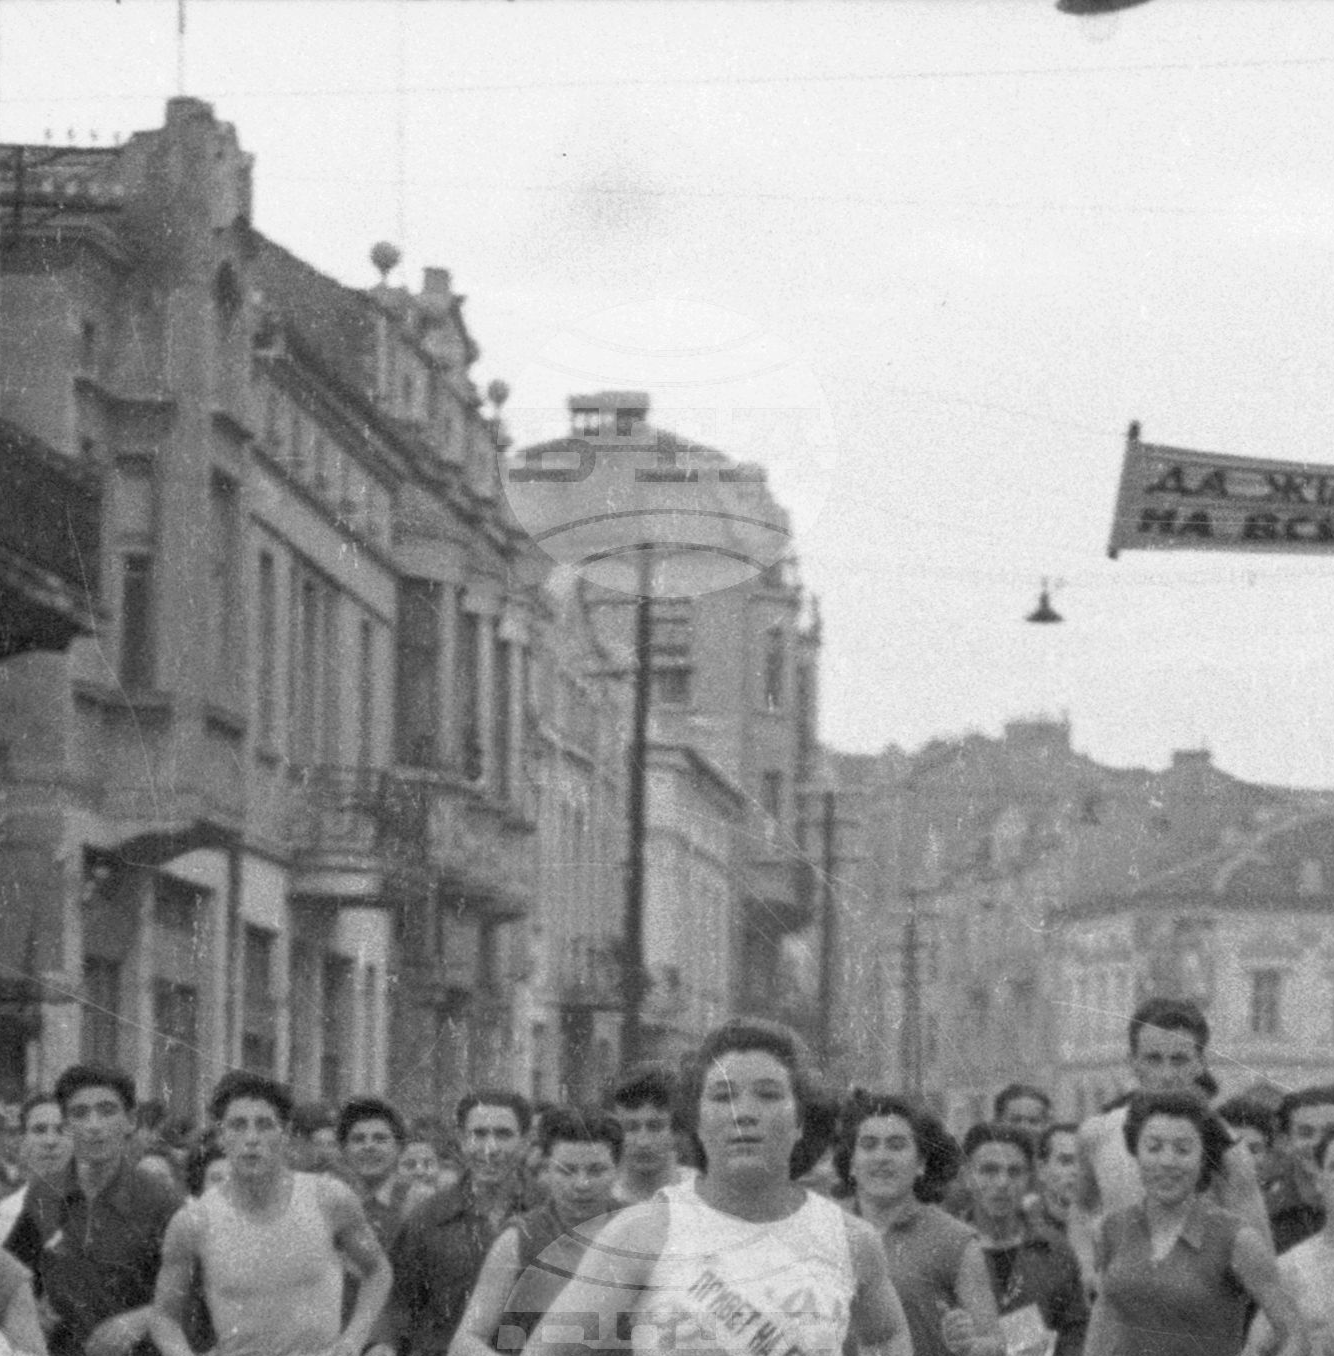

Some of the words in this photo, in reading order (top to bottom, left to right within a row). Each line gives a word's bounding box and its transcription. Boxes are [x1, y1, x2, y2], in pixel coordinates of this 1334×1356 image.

[1144, 464, 1229, 499] ДА
[1137, 507, 1215, 540] НА
[688, 1269, 761, 1335] ПРИВЕТ
